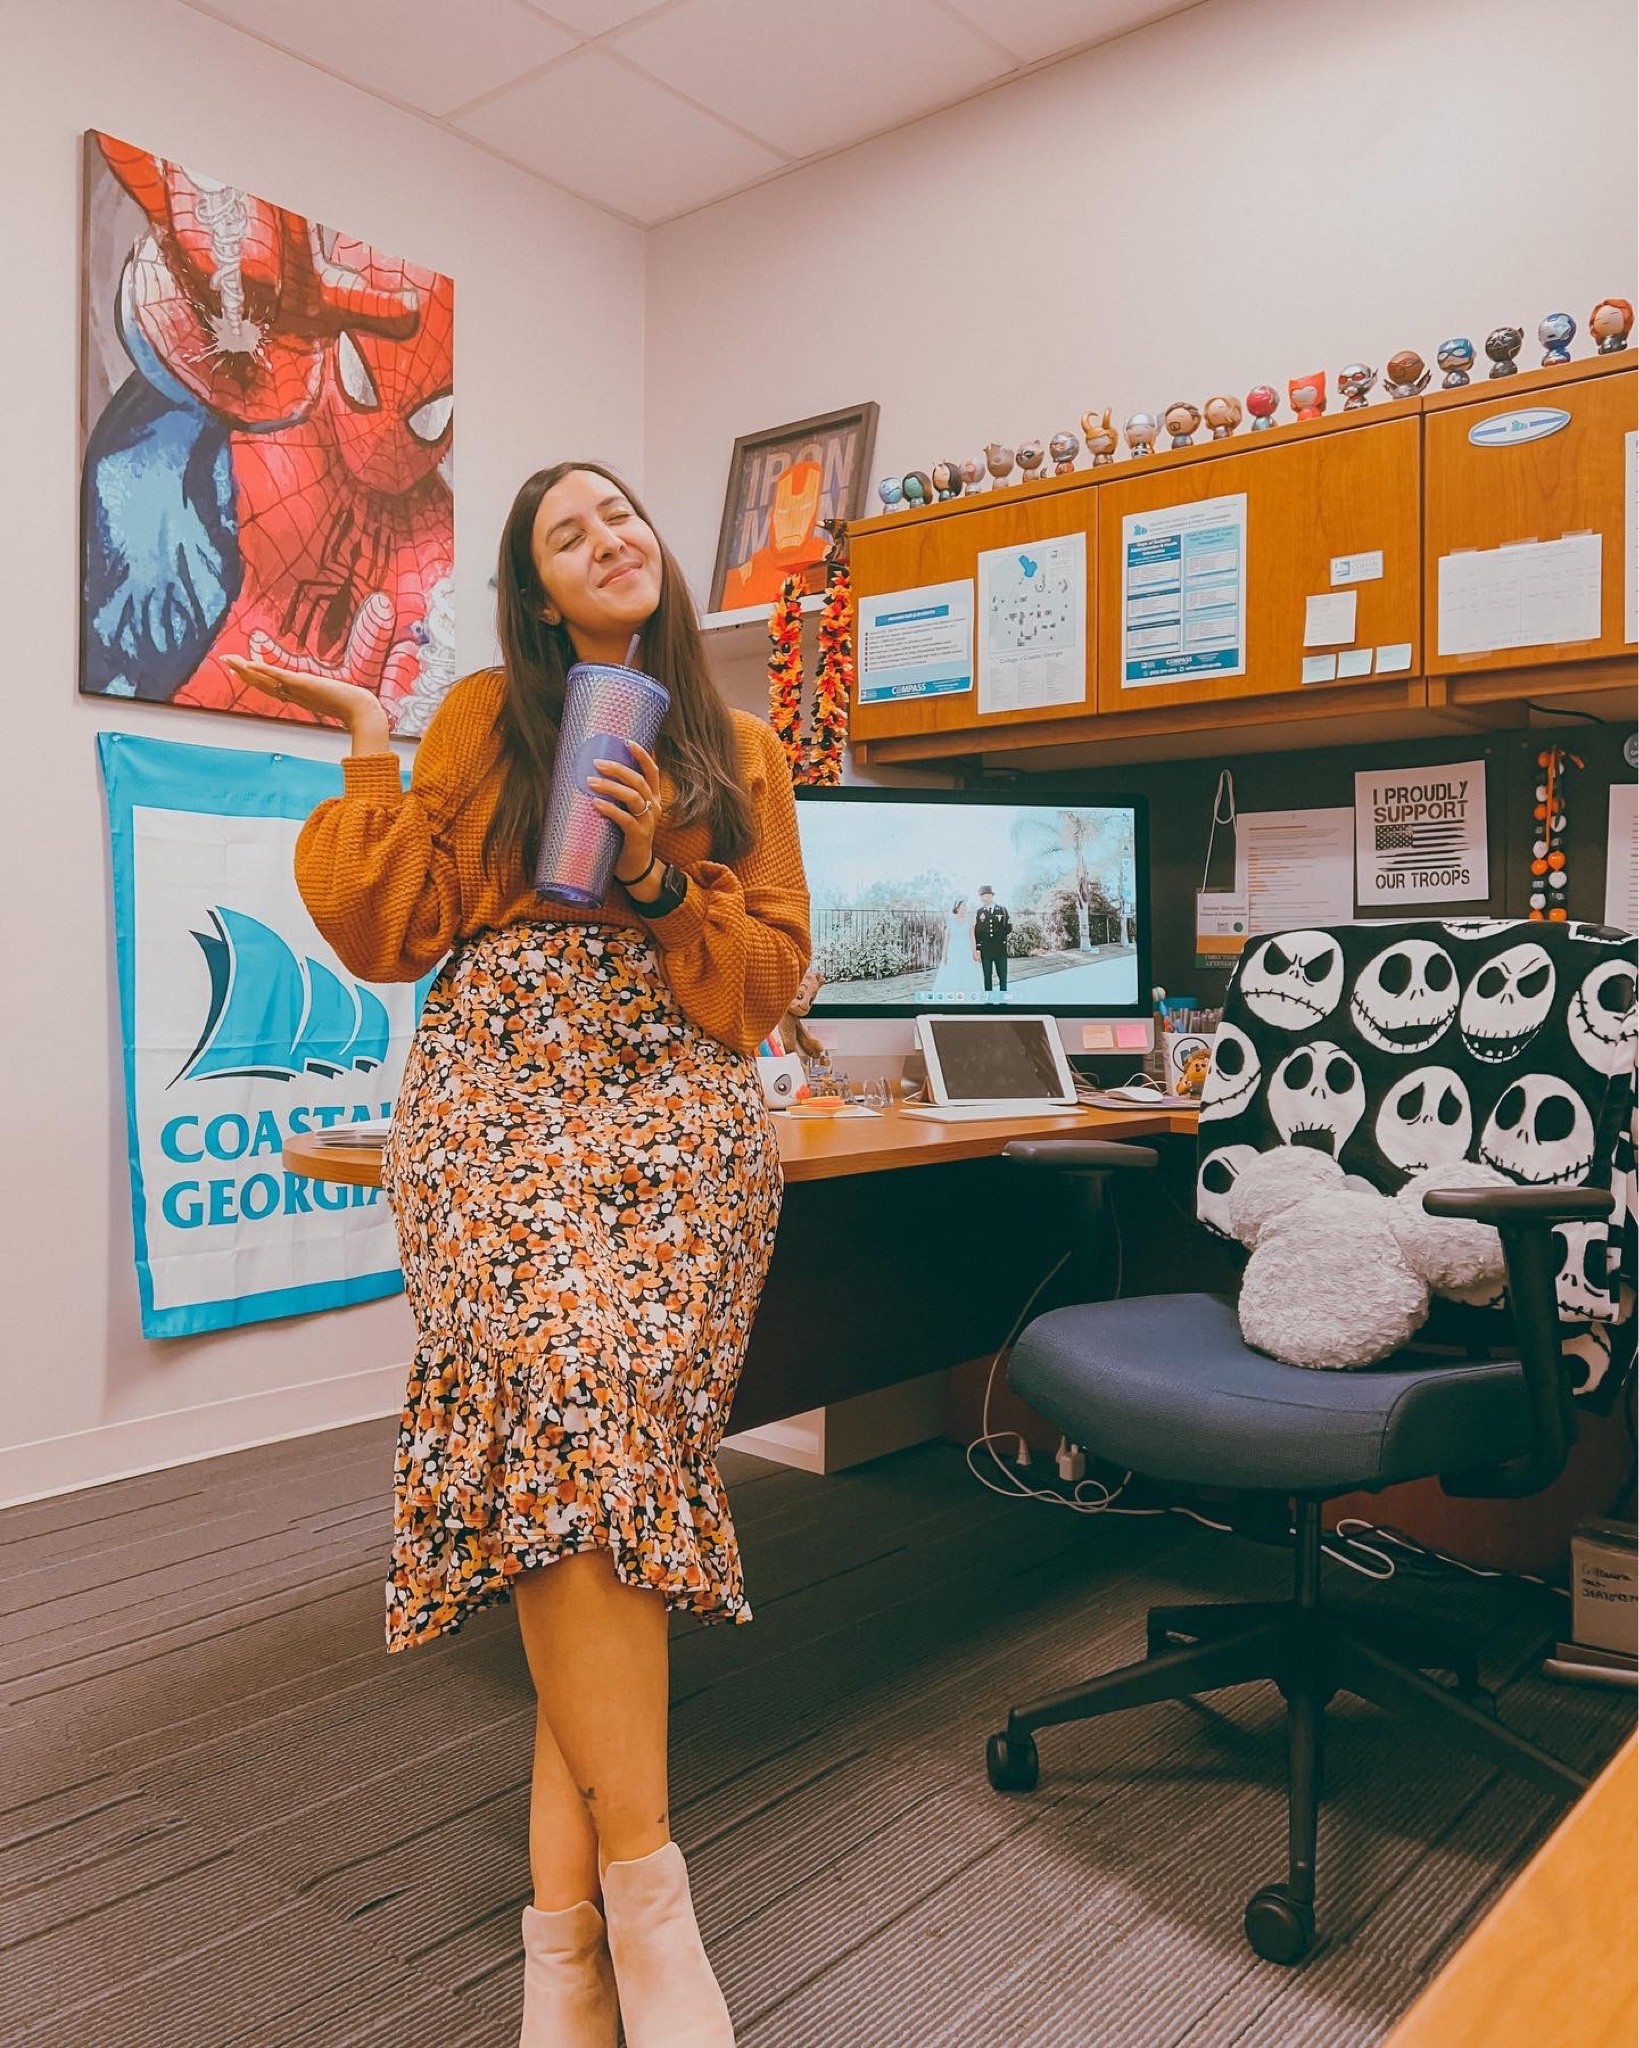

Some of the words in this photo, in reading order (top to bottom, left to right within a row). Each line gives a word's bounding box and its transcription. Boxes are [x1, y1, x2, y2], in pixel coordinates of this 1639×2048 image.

[892, 682, 927, 695] COMPASS
[1372, 788, 1378, 806] I
[1384, 781, 1468, 805] PROUDLY
[1374, 800, 1469, 823] SUPPORT
[1375, 873, 1405, 890] OUR
[1410, 868, 1470, 888] TROOPS
